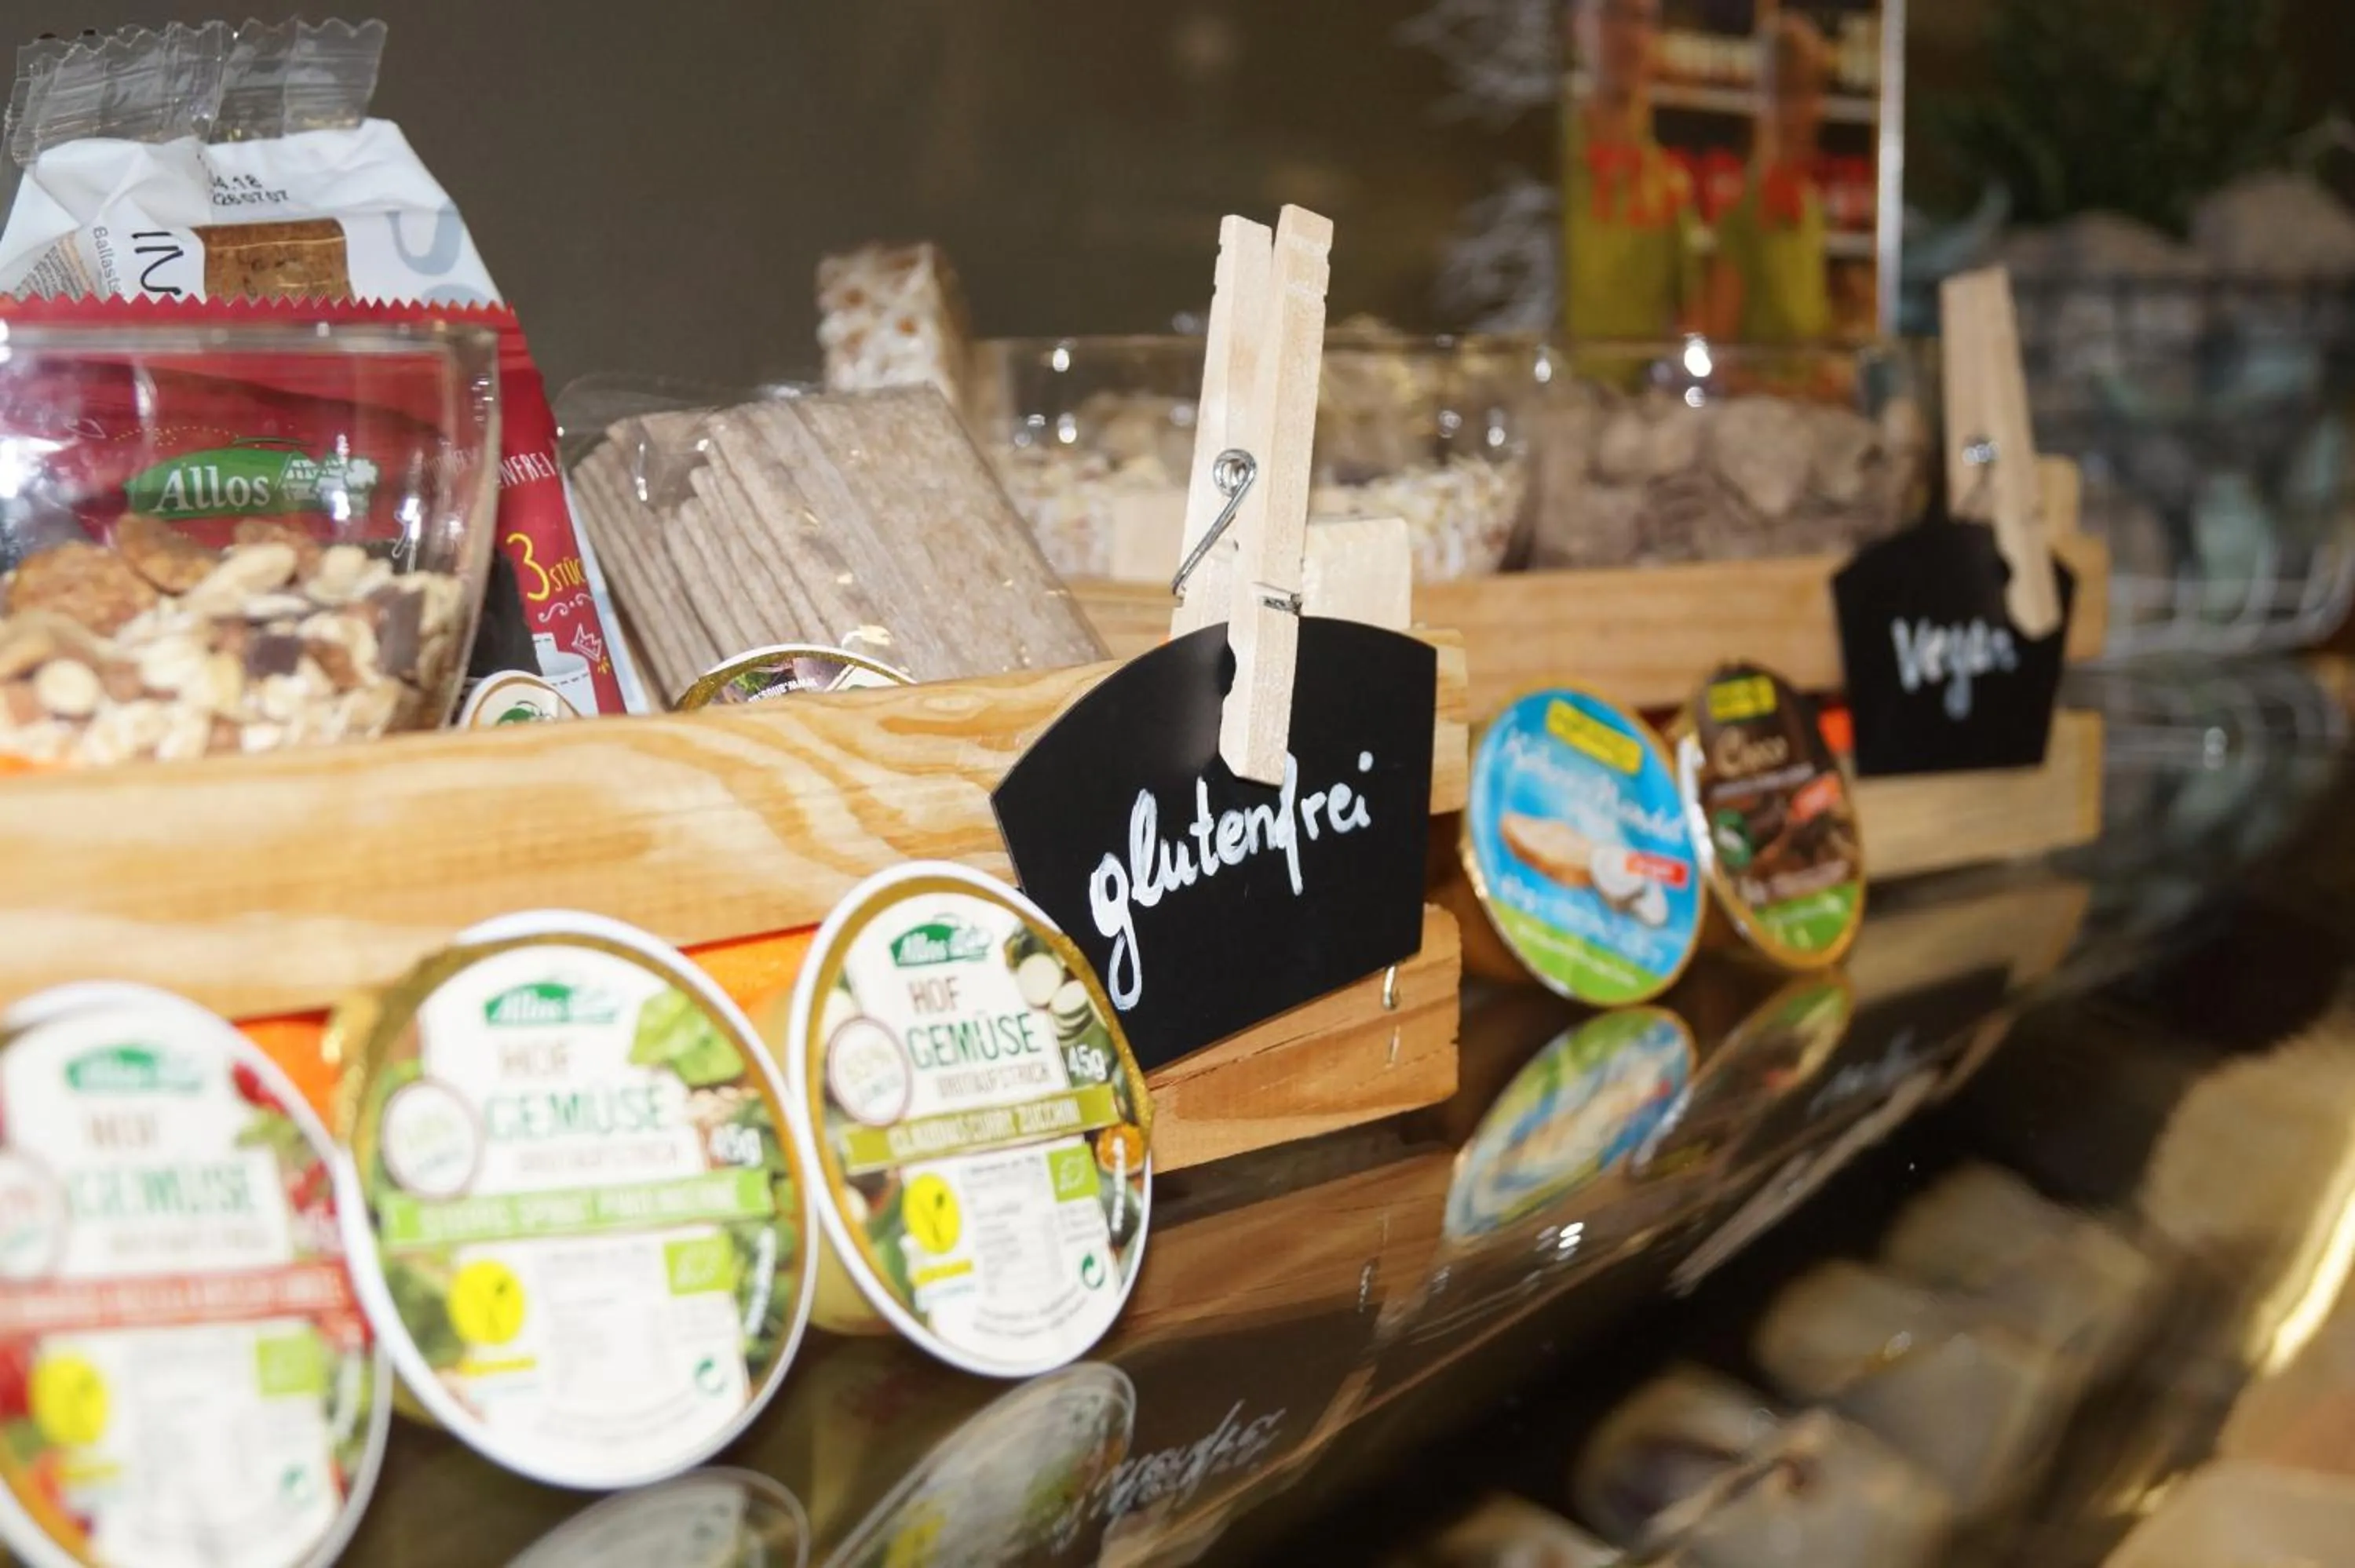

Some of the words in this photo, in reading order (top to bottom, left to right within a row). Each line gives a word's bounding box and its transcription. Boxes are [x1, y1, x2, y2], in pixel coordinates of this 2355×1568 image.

[149, 465, 271, 513] Allos
[506, 532, 550, 600] 3
[1090, 750, 1371, 1011] glutenfrei
[909, 977, 959, 1014] HOF
[907, 1010, 1042, 1069] GEMÜSE
